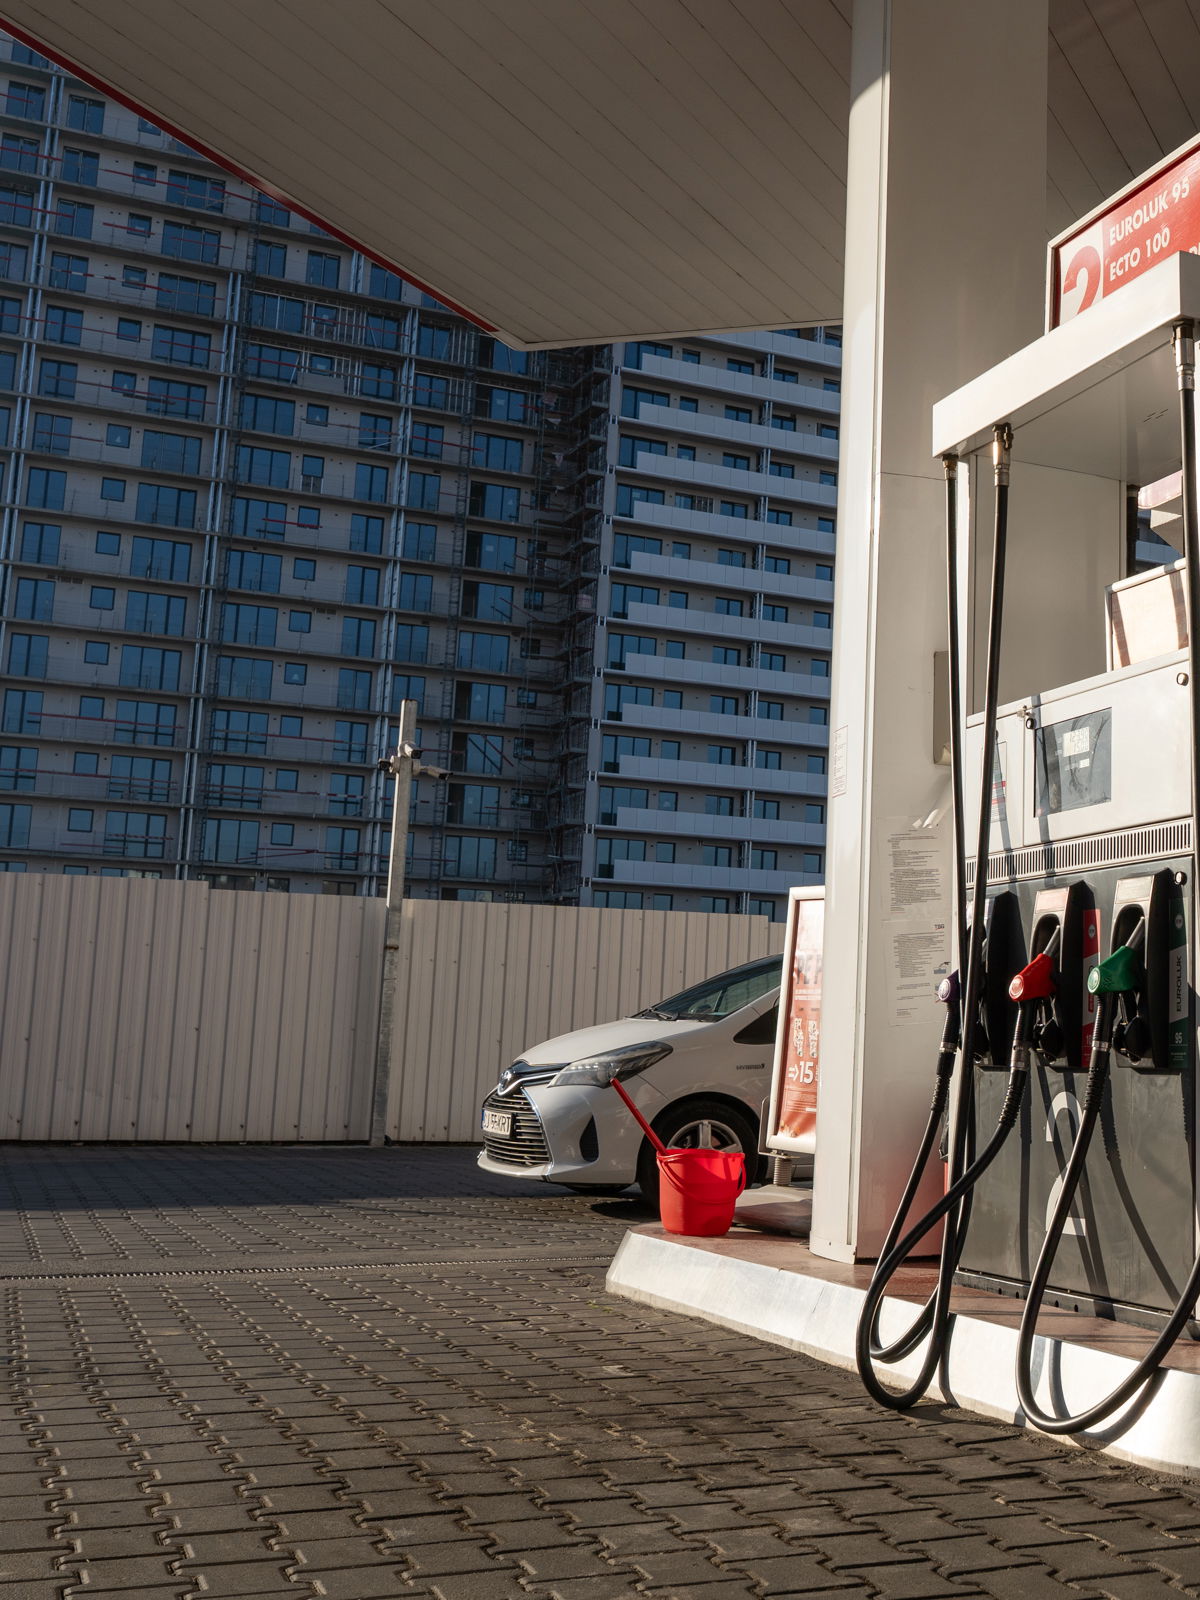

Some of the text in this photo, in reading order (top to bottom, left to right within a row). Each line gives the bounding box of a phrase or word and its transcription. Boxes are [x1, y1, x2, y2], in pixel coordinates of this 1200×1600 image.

[1109, 176, 1190, 247] EUROLUK 95
[1063, 244, 1101, 316] 2
[1109, 227, 1170, 282] ECTO 100
[799, 1061, 814, 1084] 15
